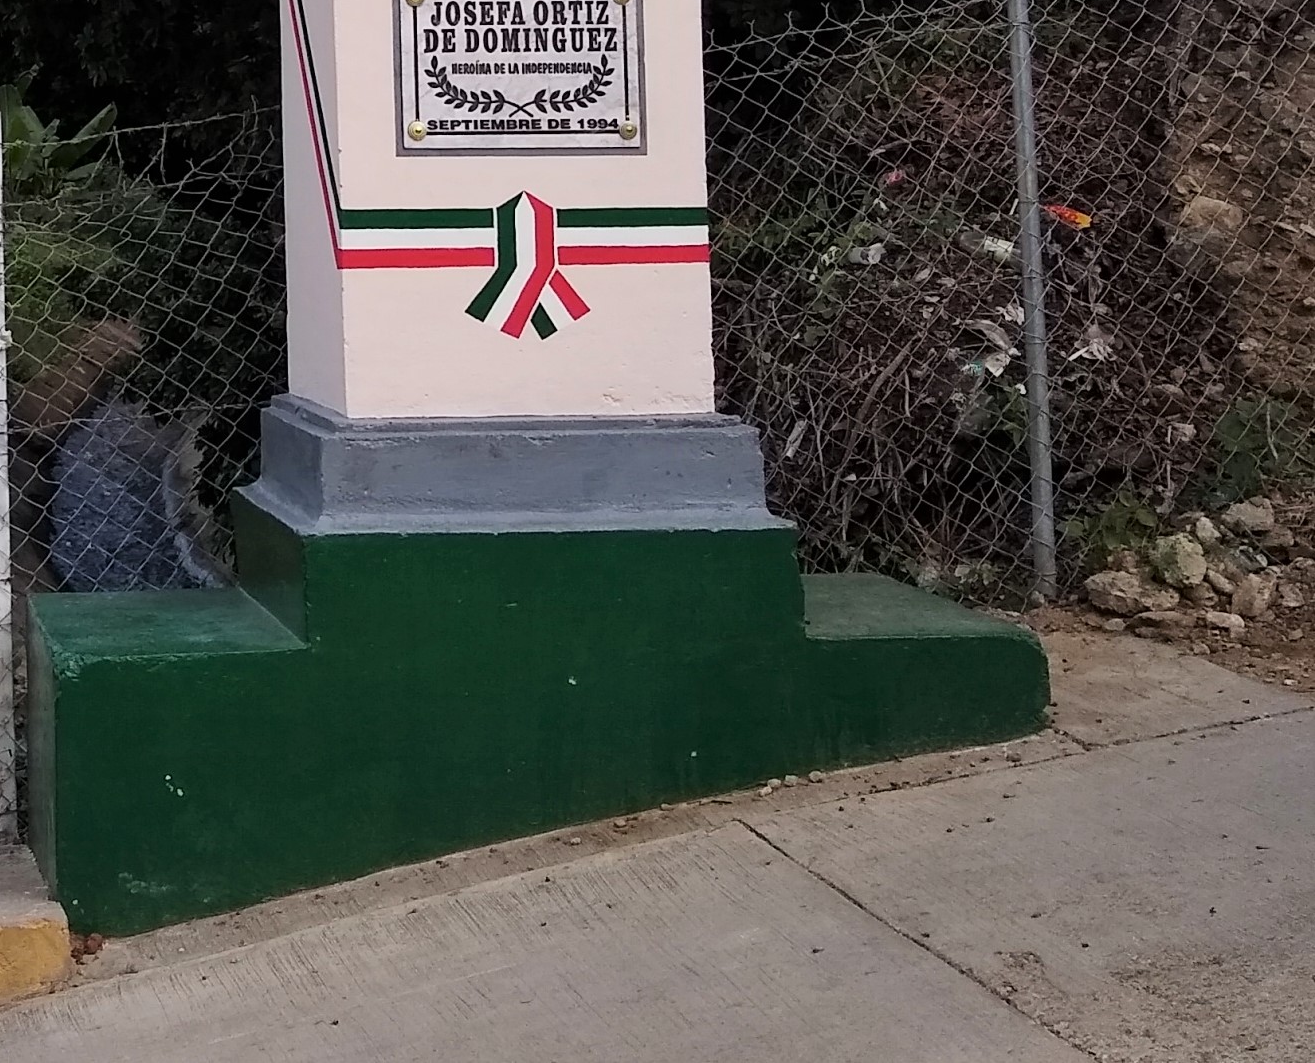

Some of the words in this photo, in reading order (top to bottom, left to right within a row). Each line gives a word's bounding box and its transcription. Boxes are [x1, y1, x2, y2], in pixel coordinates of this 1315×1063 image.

[431, 1, 525, 26] JOSEFA
[533, 1, 609, 25] ORTIZ
[423, 29, 456, 53] DE
[465, 28, 618, 53] DOMINGUEZ
[494, 63, 506, 74] DE
[509, 63, 519, 74] LA
[522, 63, 592, 74] INDEPENDENCIA
[427, 120, 542, 130] SEPTIEMBRE
[548, 120, 571, 129] DE
[578, 119, 619, 129] 1994
